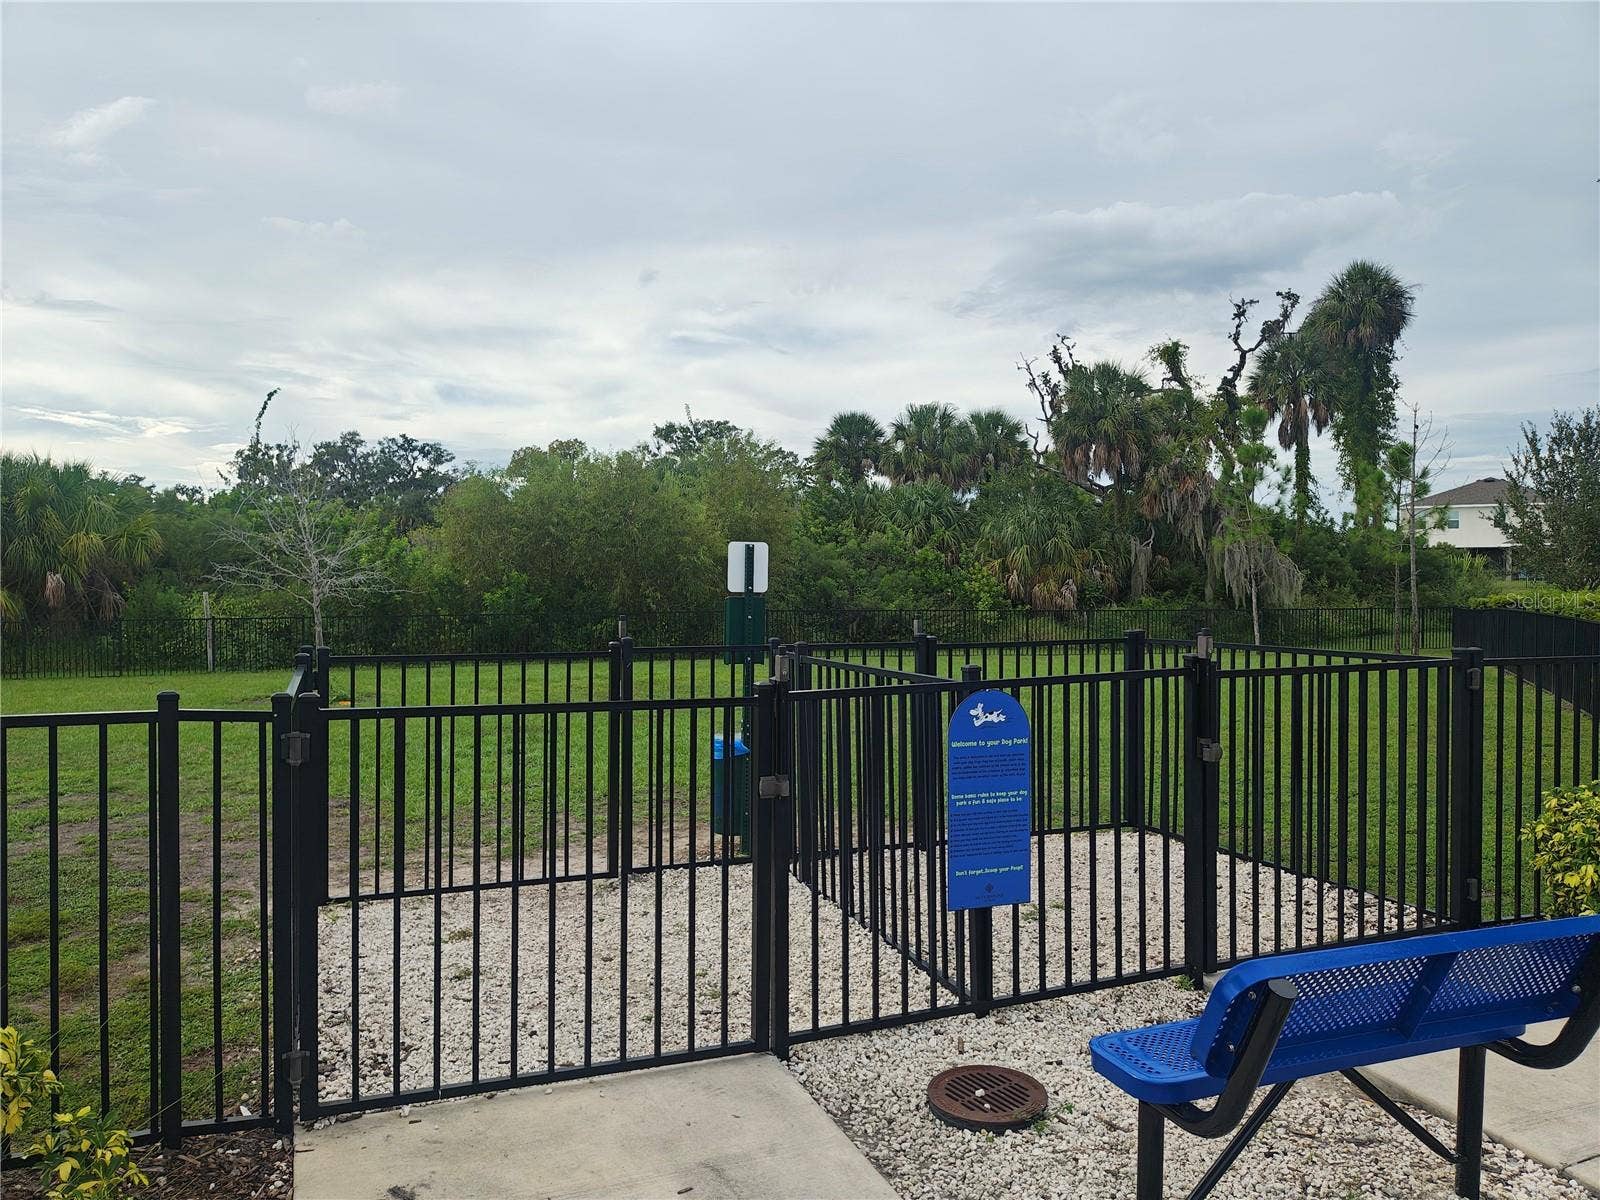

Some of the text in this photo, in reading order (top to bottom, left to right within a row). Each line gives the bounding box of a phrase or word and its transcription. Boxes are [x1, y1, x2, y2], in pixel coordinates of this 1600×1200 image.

[951, 740, 977, 748] Welcome
[986, 740, 1000, 748] your
[1001, 738, 1013, 746] Dog
[1013, 737, 1028, 745] Park!
[1019, 789, 1028, 797] dog
[956, 799, 967, 807] park
